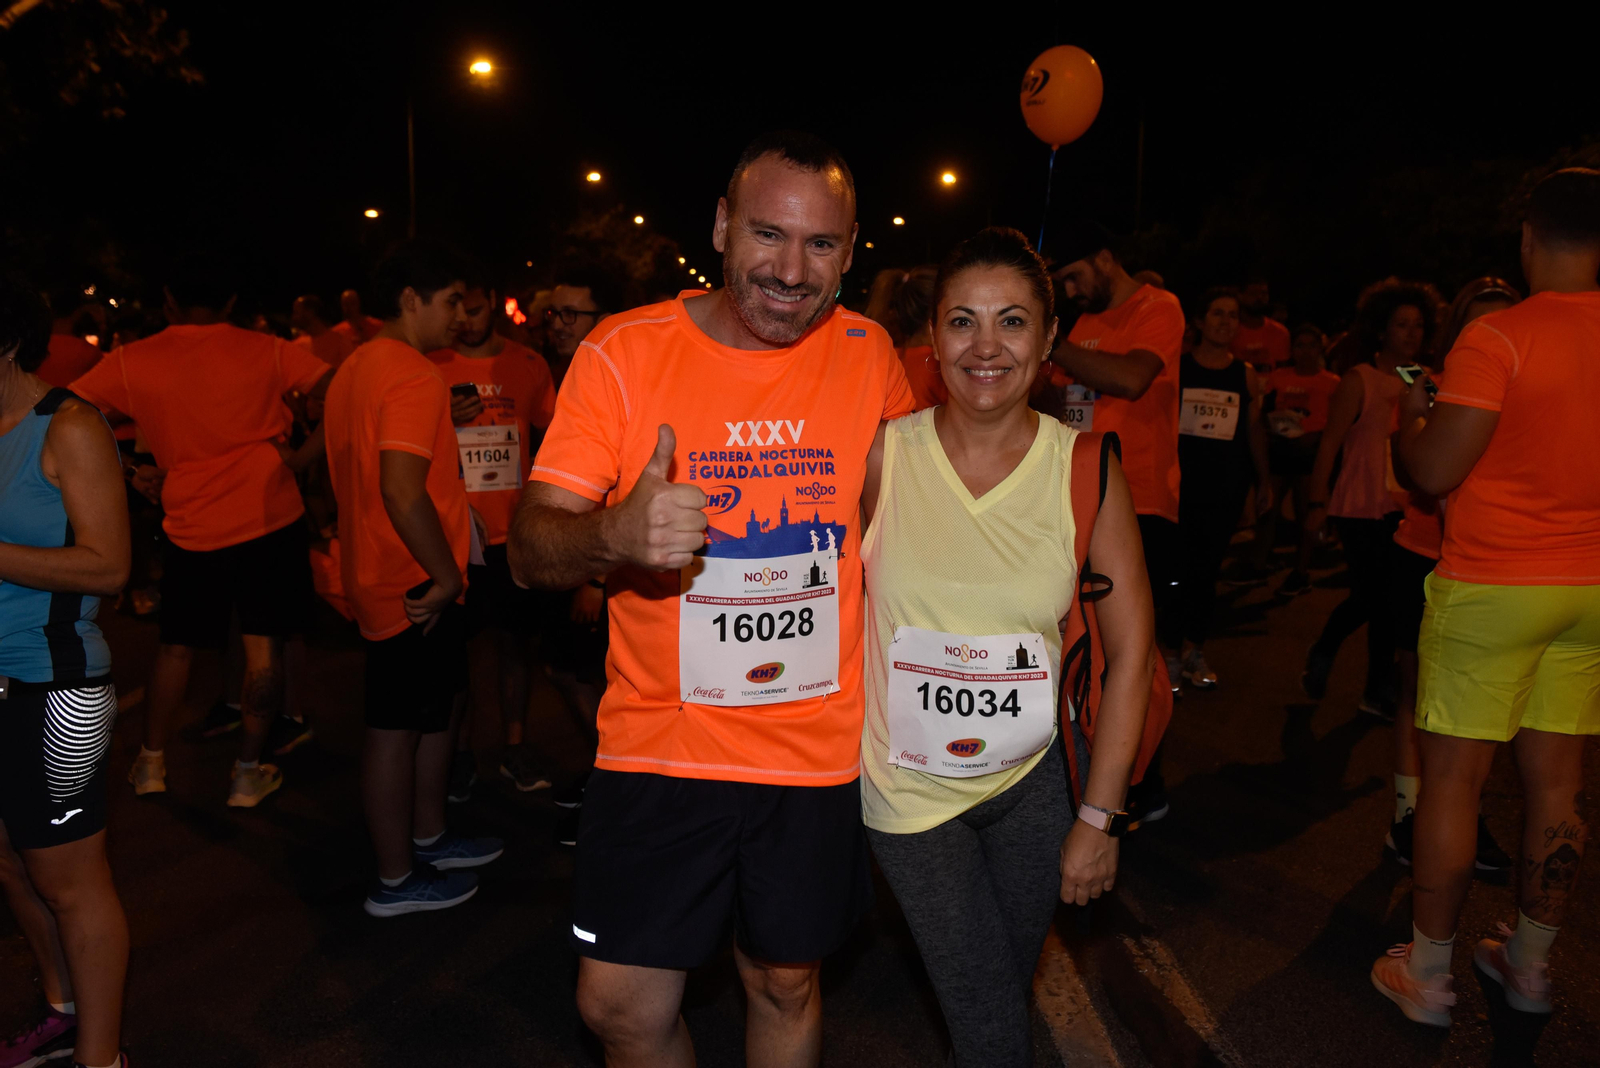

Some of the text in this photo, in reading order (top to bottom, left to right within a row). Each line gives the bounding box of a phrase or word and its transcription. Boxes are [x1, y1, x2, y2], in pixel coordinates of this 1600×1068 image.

[724, 419, 806, 447] XXXV
[465, 449, 510, 464] 11604
[688, 448, 835, 462] CARRERA NOCTURNA
[689, 463, 697, 480] DEL
[699, 461, 836, 480] GUADALQUIVIR
[775, 592, 812, 602] GUADALQUIVIR
[712, 607, 814, 643] 16028
[896, 662, 911, 670] XXXV
[911, 666, 935, 674] CARRERA
[935, 669, 963, 679] NOCTURNA
[916, 681, 1021, 718] 16034
